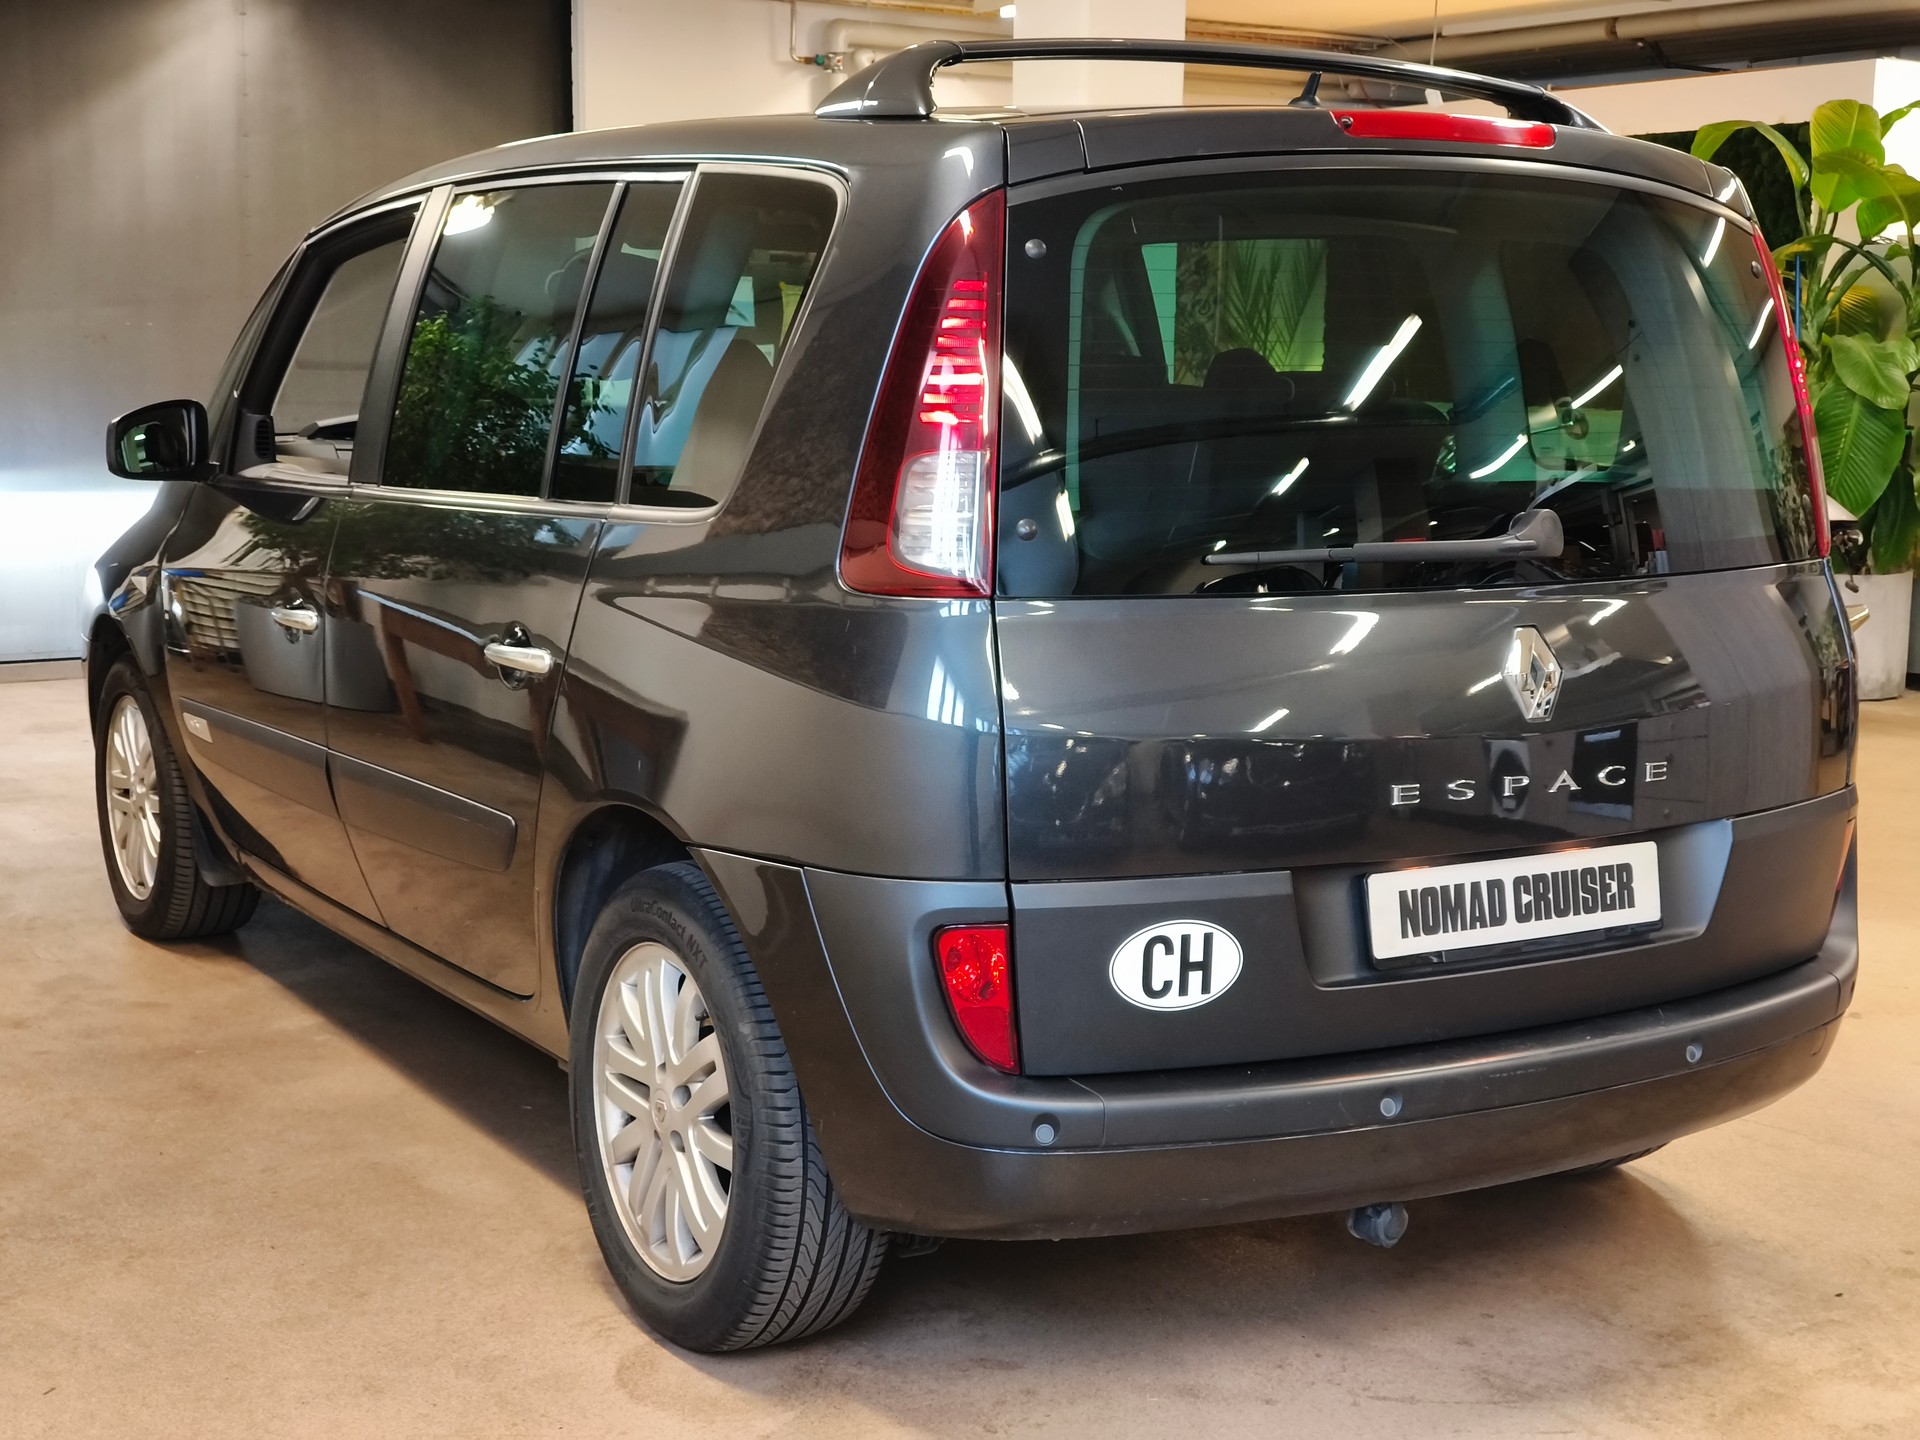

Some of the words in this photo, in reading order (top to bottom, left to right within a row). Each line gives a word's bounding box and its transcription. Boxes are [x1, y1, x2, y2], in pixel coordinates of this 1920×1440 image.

[1391, 761, 1668, 806] ESPACE
[1398, 878, 1508, 940] NOMAD
[1512, 862, 1636, 924] CRUISER
[686, 934, 708, 969] NXT
[1141, 931, 1214, 1000] CH
